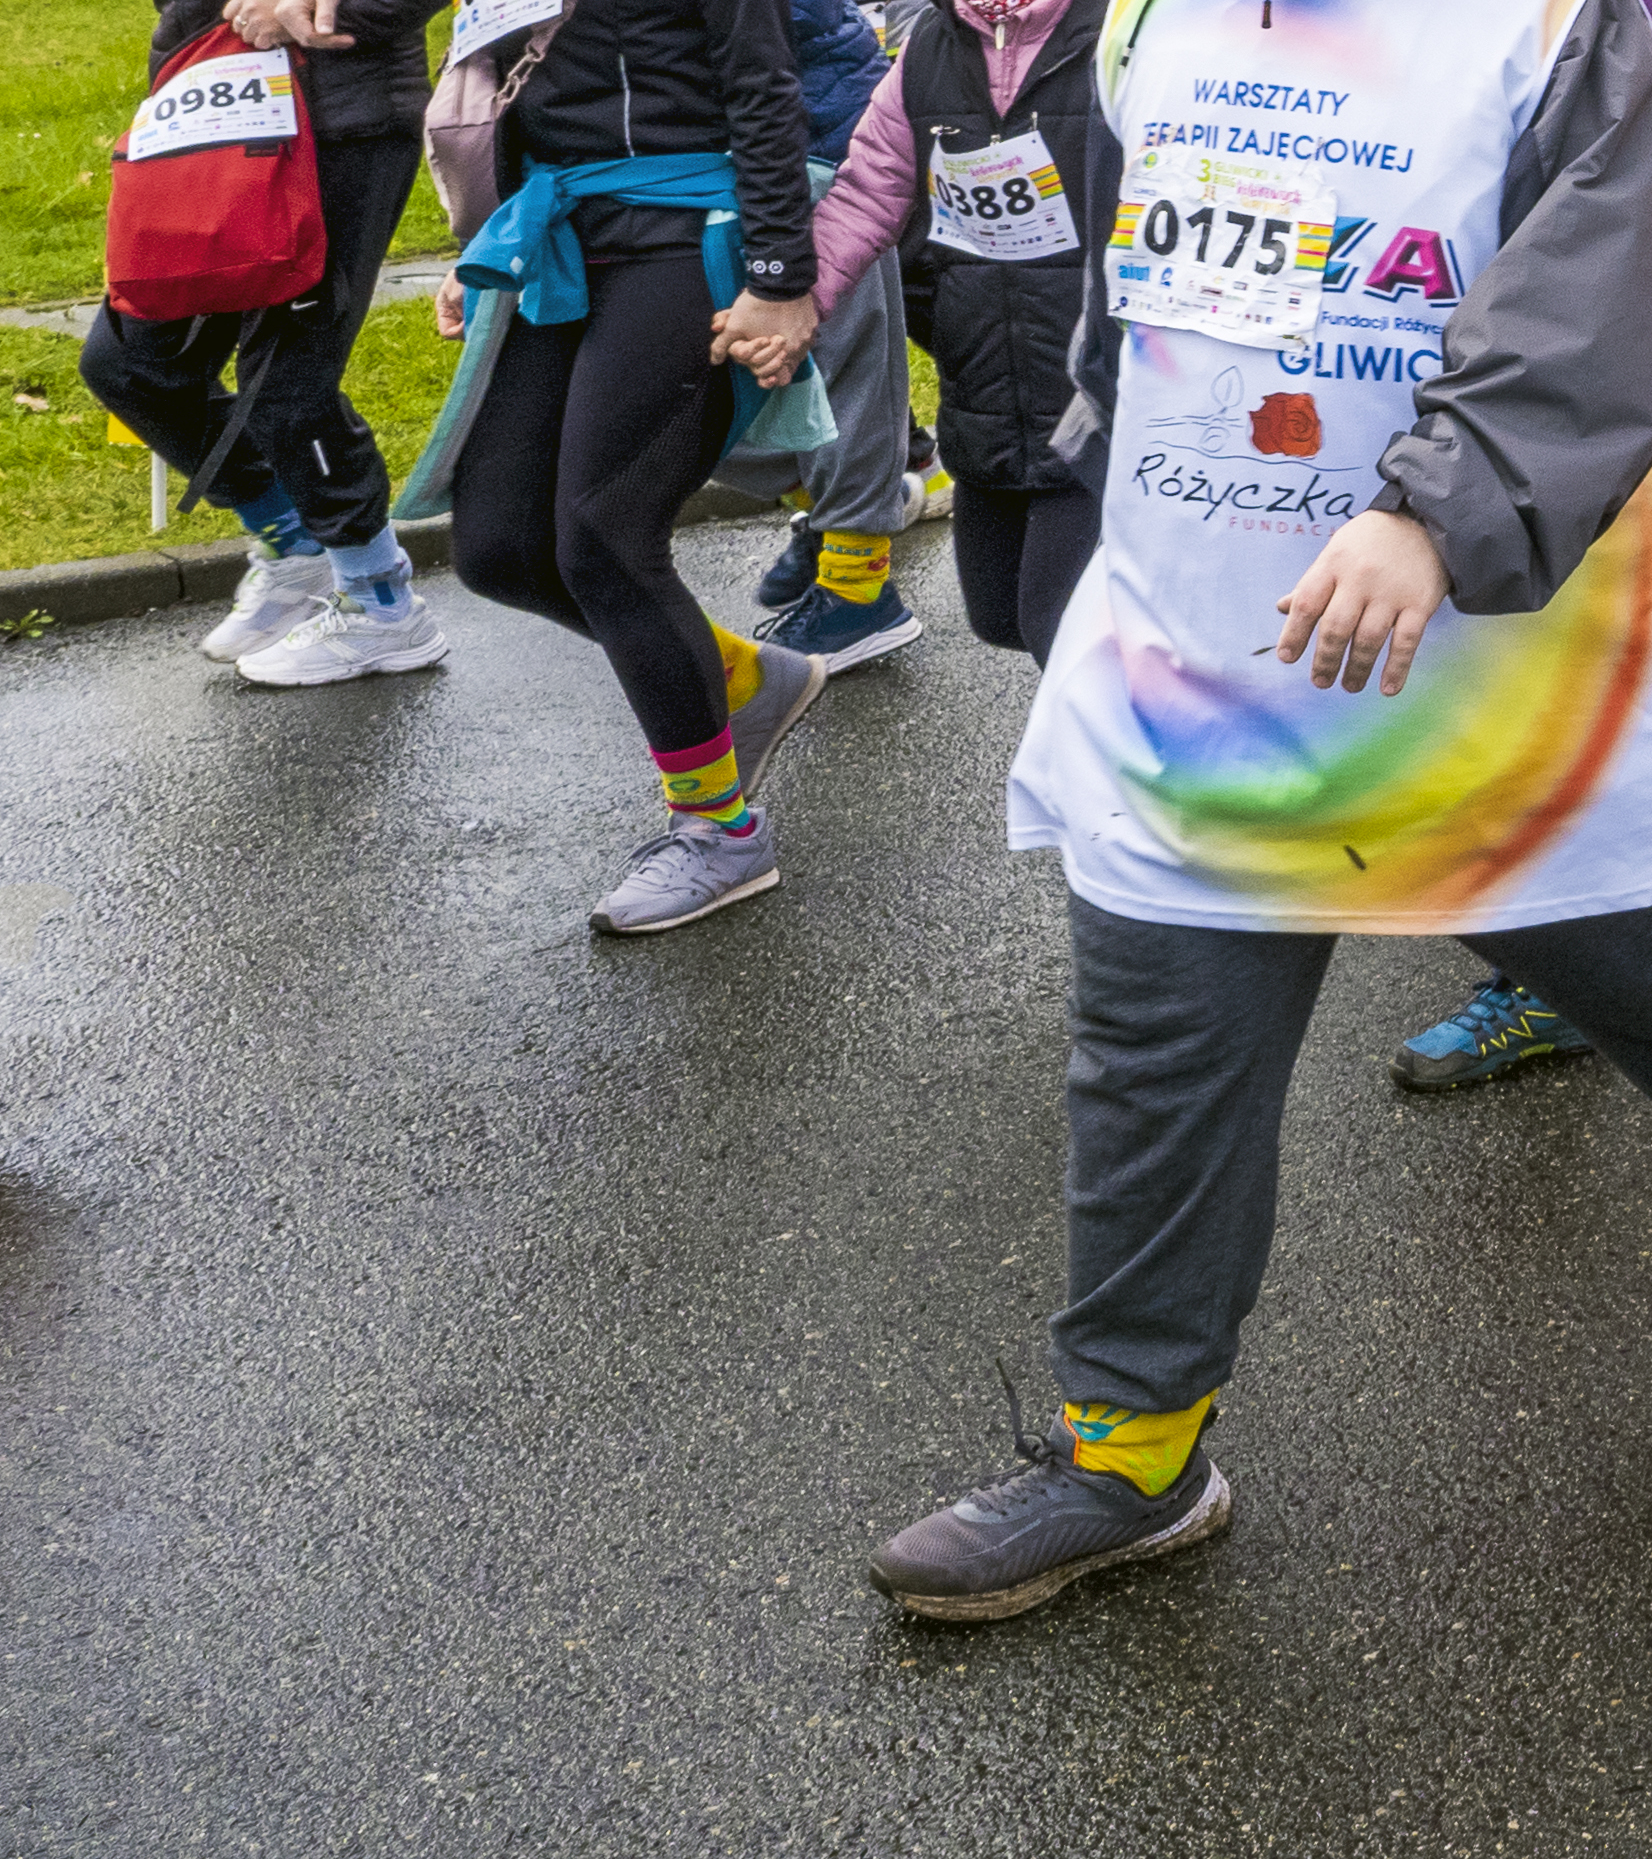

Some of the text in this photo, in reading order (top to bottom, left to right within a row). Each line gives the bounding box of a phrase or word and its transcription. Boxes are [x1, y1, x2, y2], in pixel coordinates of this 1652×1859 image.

[154, 78, 267, 122] 0984
[1194, 78, 1351, 117] WARSZTATY
[1197, 158, 1211, 182] 3
[1226, 126, 1415, 174] ZAJĘCIOWEJ
[935, 176, 1036, 221] 0388
[1144, 199, 1295, 276] 0175
[1132, 452, 1355, 521] Różyczka
